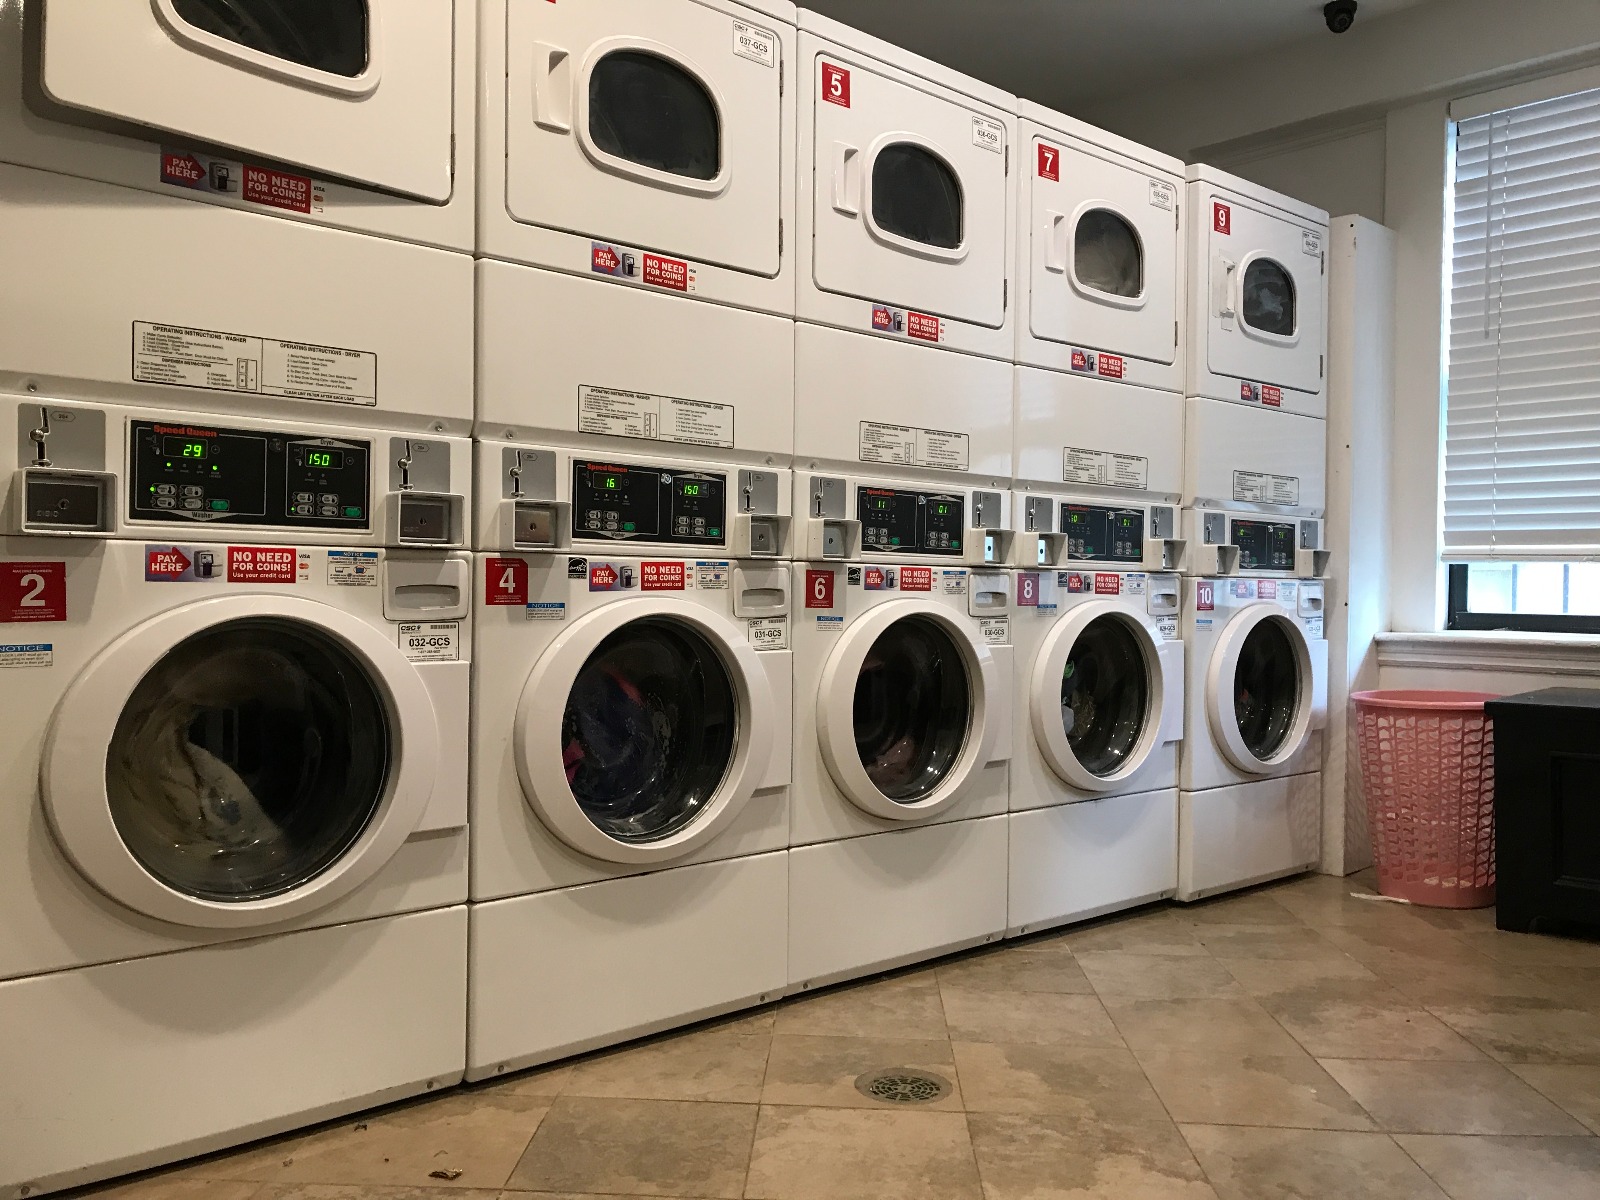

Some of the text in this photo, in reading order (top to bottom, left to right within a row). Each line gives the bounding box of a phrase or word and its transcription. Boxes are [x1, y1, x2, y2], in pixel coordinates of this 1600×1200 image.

[740, 36, 768, 52] 037-GCS
[831, 74, 842, 96] 5
[172, 158, 192, 169] PAY
[1044, 152, 1053, 171] 7
[166, 165, 198, 180] HERE
[248, 170, 306, 191] NO NEED
[248, 181, 306, 200] FOR COINS!
[248, 191, 259, 199] Use
[1219, 210, 1225, 226] 9
[595, 258, 615, 267] HERE
[646, 258, 684, 274] NO NEED
[647, 267, 684, 281] FOR COINS!
[921, 318, 936, 327] NEED
[153, 325, 183, 335] OPERATING
[184, 330, 222, 339] INSTRUCTIONS
[154, 424, 217, 437] Speed Queen
[183, 444, 201, 457] 29
[309, 454, 329, 465] 150
[607, 478, 614, 487] 16
[684, 484, 698, 494] 150
[157, 555, 177, 563] PAY
[233, 552, 291, 563] NO NEED
[151, 563, 183, 572] HERE
[233, 562, 291, 572] FOR COINS!
[499, 568, 515, 593] 4
[20, 574, 46, 606] 2
[815, 578, 825, 599] 6
[1024, 580, 1032, 598] 8
[1200, 588, 1212, 604] 10
[755, 630, 781, 638] 031-GCS
[409, 637, 450, 647] 032-GCS
